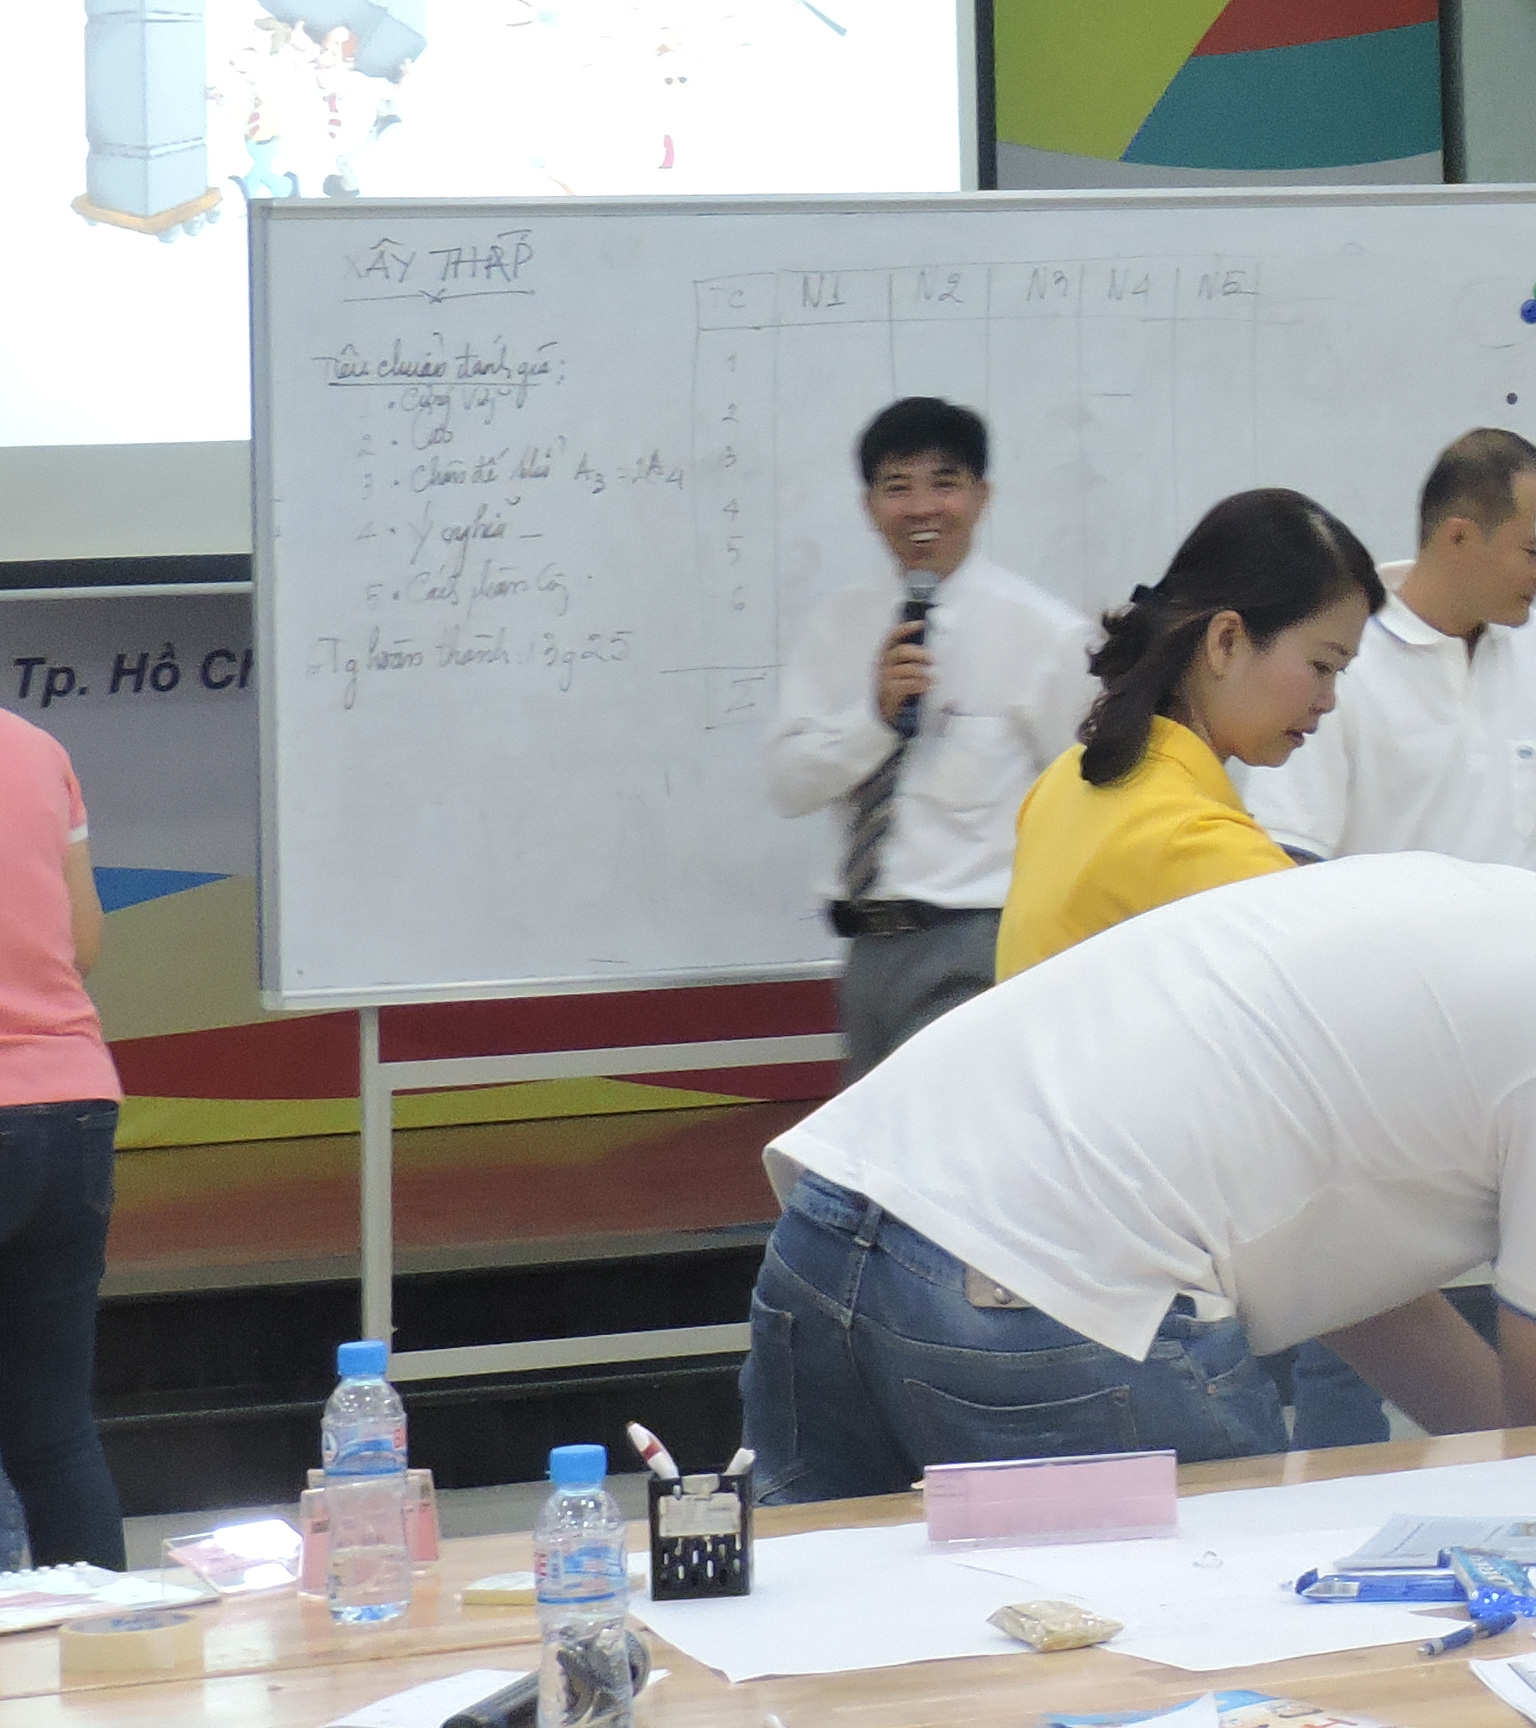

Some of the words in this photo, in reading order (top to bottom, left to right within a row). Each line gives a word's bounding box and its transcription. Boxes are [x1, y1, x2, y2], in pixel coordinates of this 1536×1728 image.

[801, 273, 847, 309] N1
[914, 269, 964, 305] N2
[12, 657, 88, 709] Tp.
[107, 641, 182, 694] Hồ
